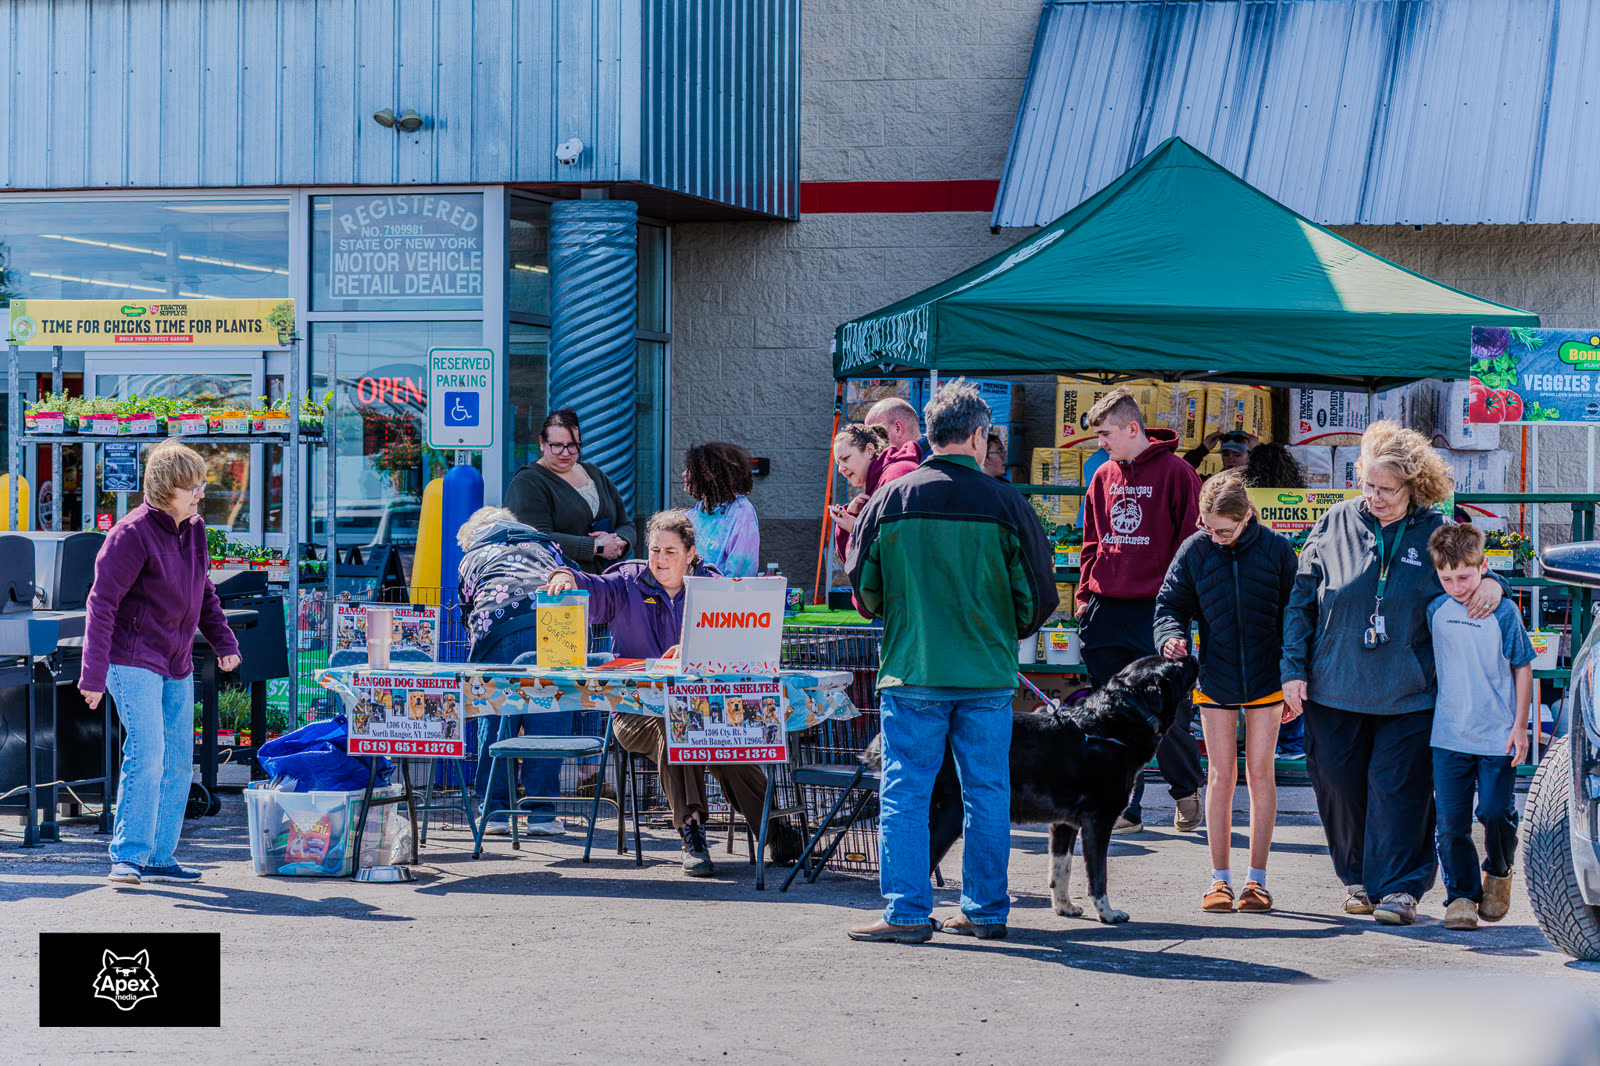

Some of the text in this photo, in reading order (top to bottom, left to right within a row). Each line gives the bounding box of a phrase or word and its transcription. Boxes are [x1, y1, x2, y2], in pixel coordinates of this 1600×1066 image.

[339, 195, 479, 234] REGISTERED
[361, 224, 424, 237] NO. 7109981
[339, 238, 477, 250] STATE OF NEW YORK
[334, 251, 482, 272] MOTOR VEHICLE
[334, 274, 482, 294] RETAIL DEALER
[42, 320, 72, 334] TIME
[76, 320, 100, 334] FOR
[155, 319, 185, 333] TIME
[189, 319, 212, 333] FOR
[433, 357, 490, 370] RESERVED
[436, 374, 487, 387] PARKING
[1524, 374, 1590, 391] VEGGIES
[357, 376, 423, 404] OPEN
[1109, 483, 1152, 498] Chaeaugay
[1312, 508, 1328, 520] TI
[338, 606, 435, 618] BANGO SHELTER
[353, 676, 460, 689] BANGOR DOG SHELTER
[668, 683, 779, 695] BANGOR DOG SHELTER
[372, 730, 387, 738] North
[389, 730, 412, 740] Bangor,
[424, 730, 441, 739] 12966
[704, 728, 719, 737] 1306
[358, 741, 454, 754] (518) 651-1376
[709, 738, 732, 747] Bangor,
[734, 737, 742, 745] NY
[744, 737, 762, 745] 12966
[678, 748, 777, 762] (518) 651-1376
